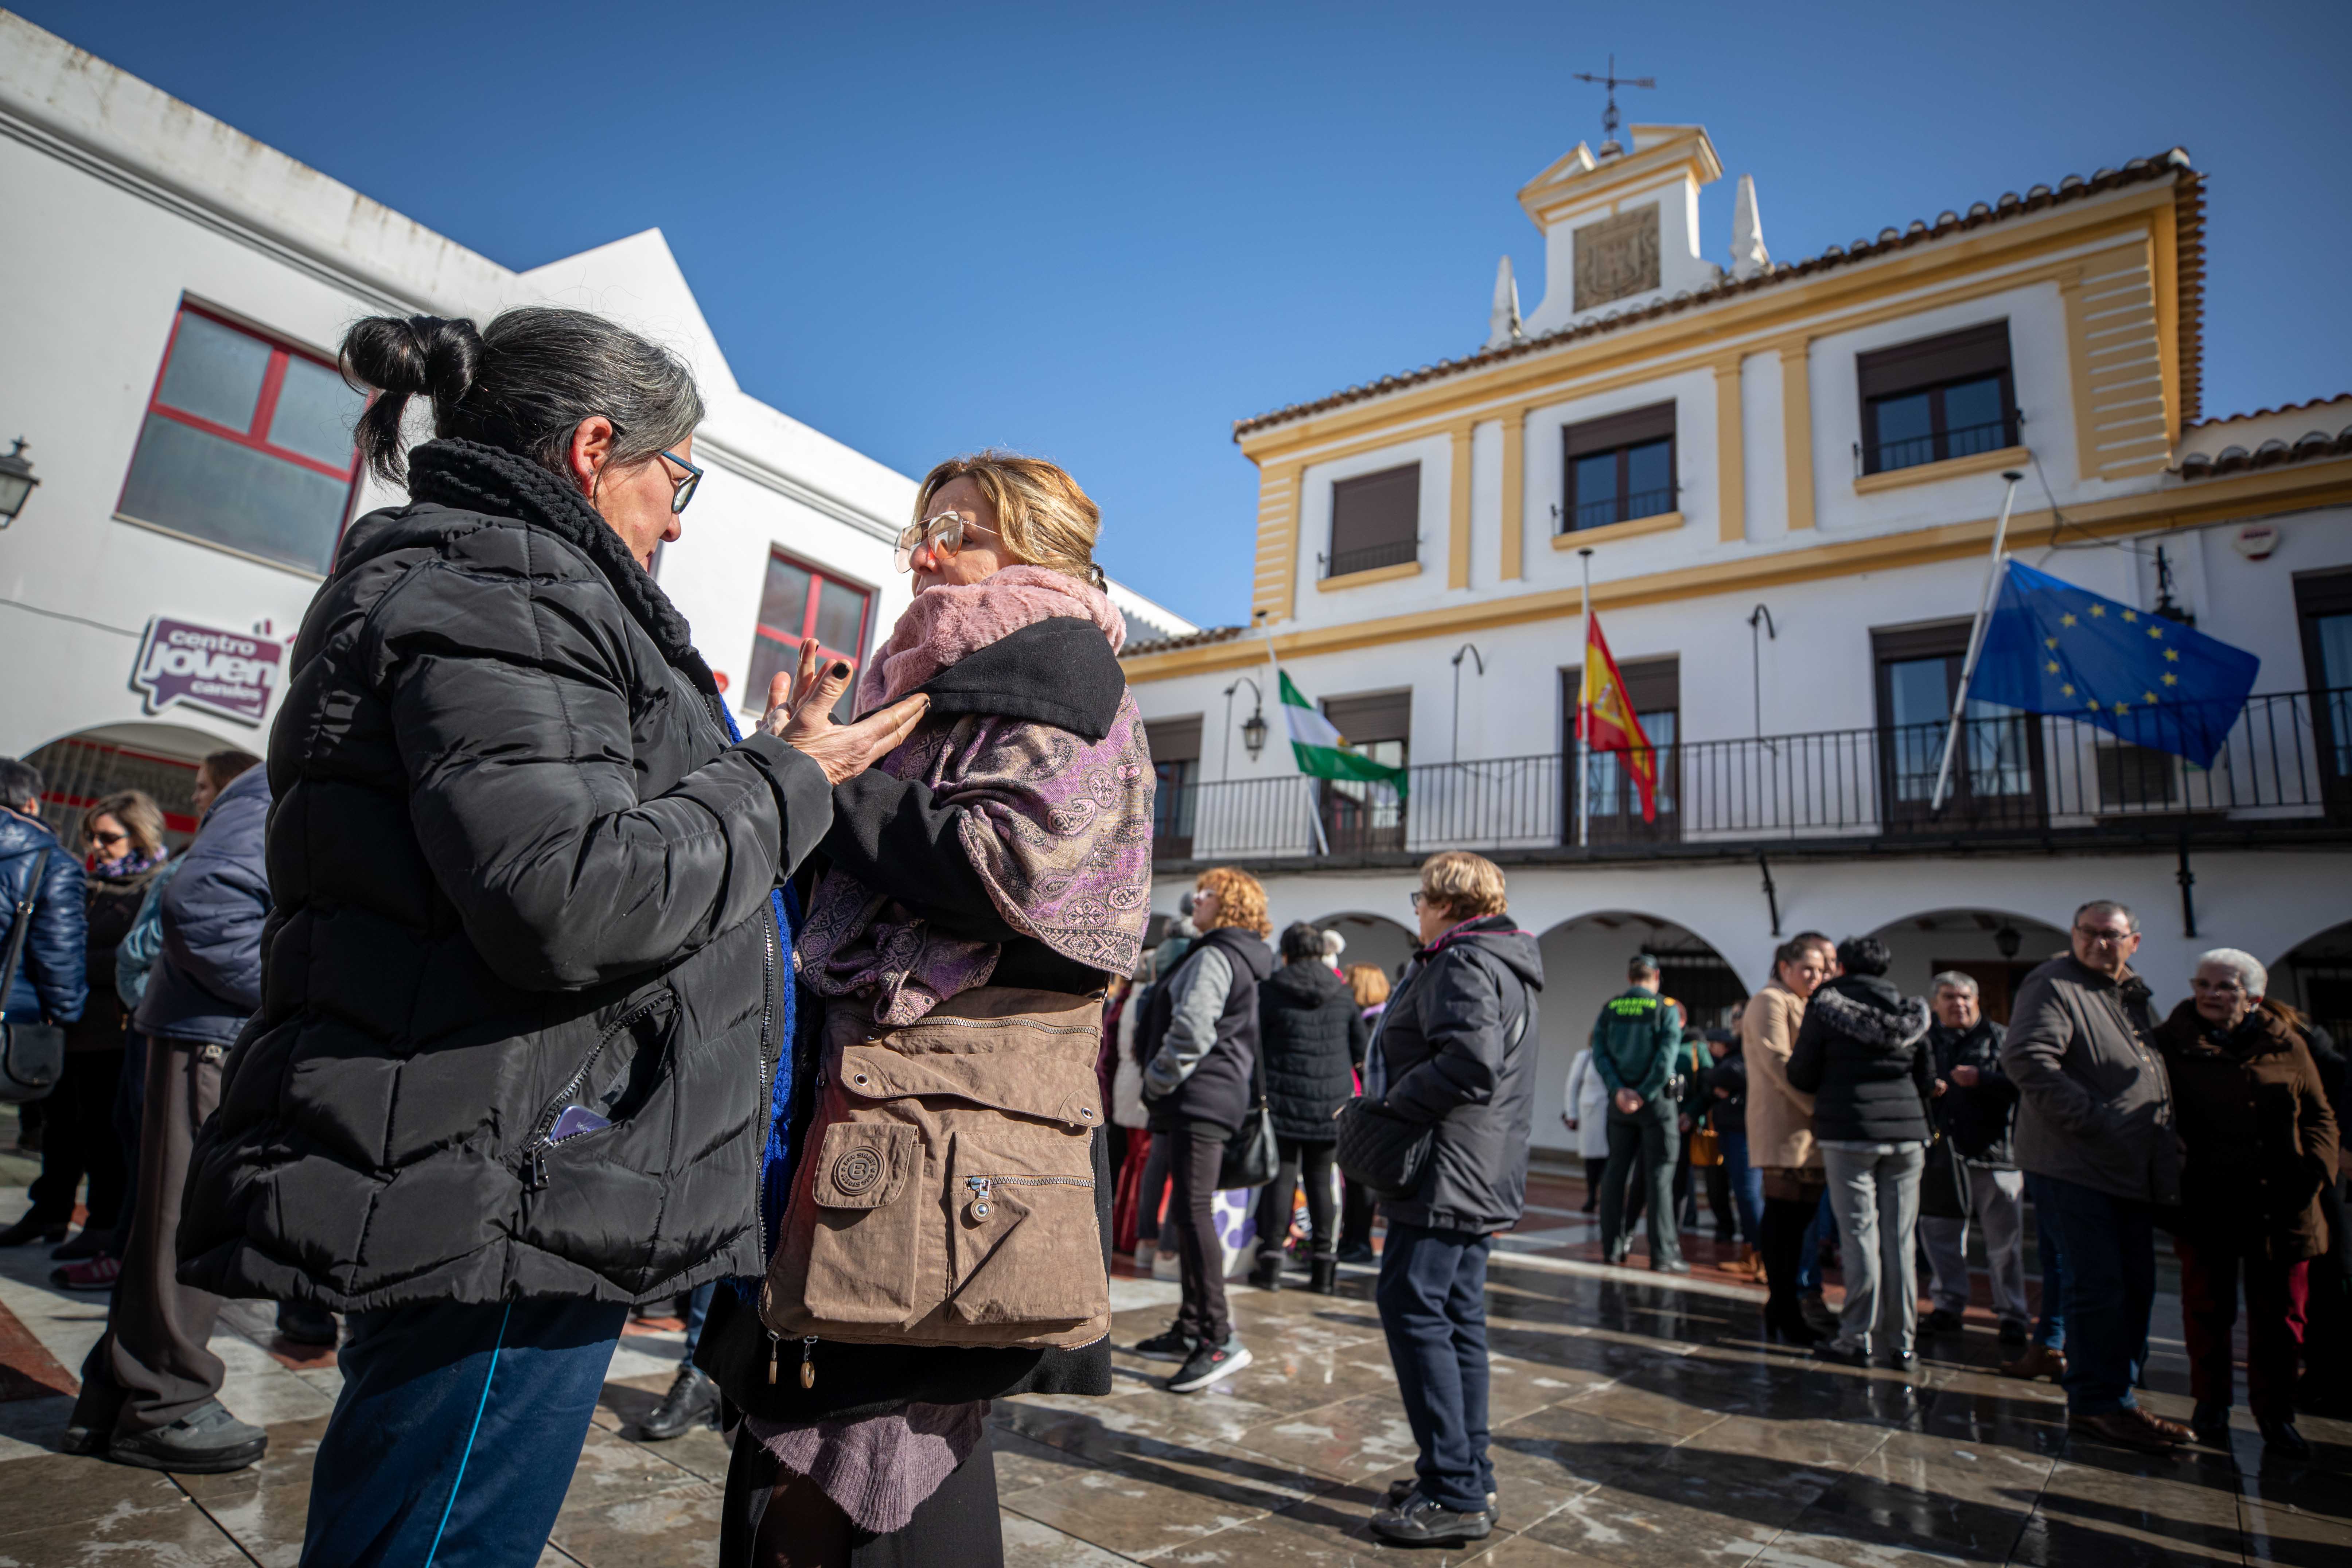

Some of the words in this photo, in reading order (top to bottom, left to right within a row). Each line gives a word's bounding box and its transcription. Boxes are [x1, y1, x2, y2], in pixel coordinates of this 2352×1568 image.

[168, 629, 256, 656] centro
[1608, 997, 1657, 1009] GUARDIA
[1616, 1006, 1643, 1015] CIVIL
[852, 1162, 867, 1175] B
